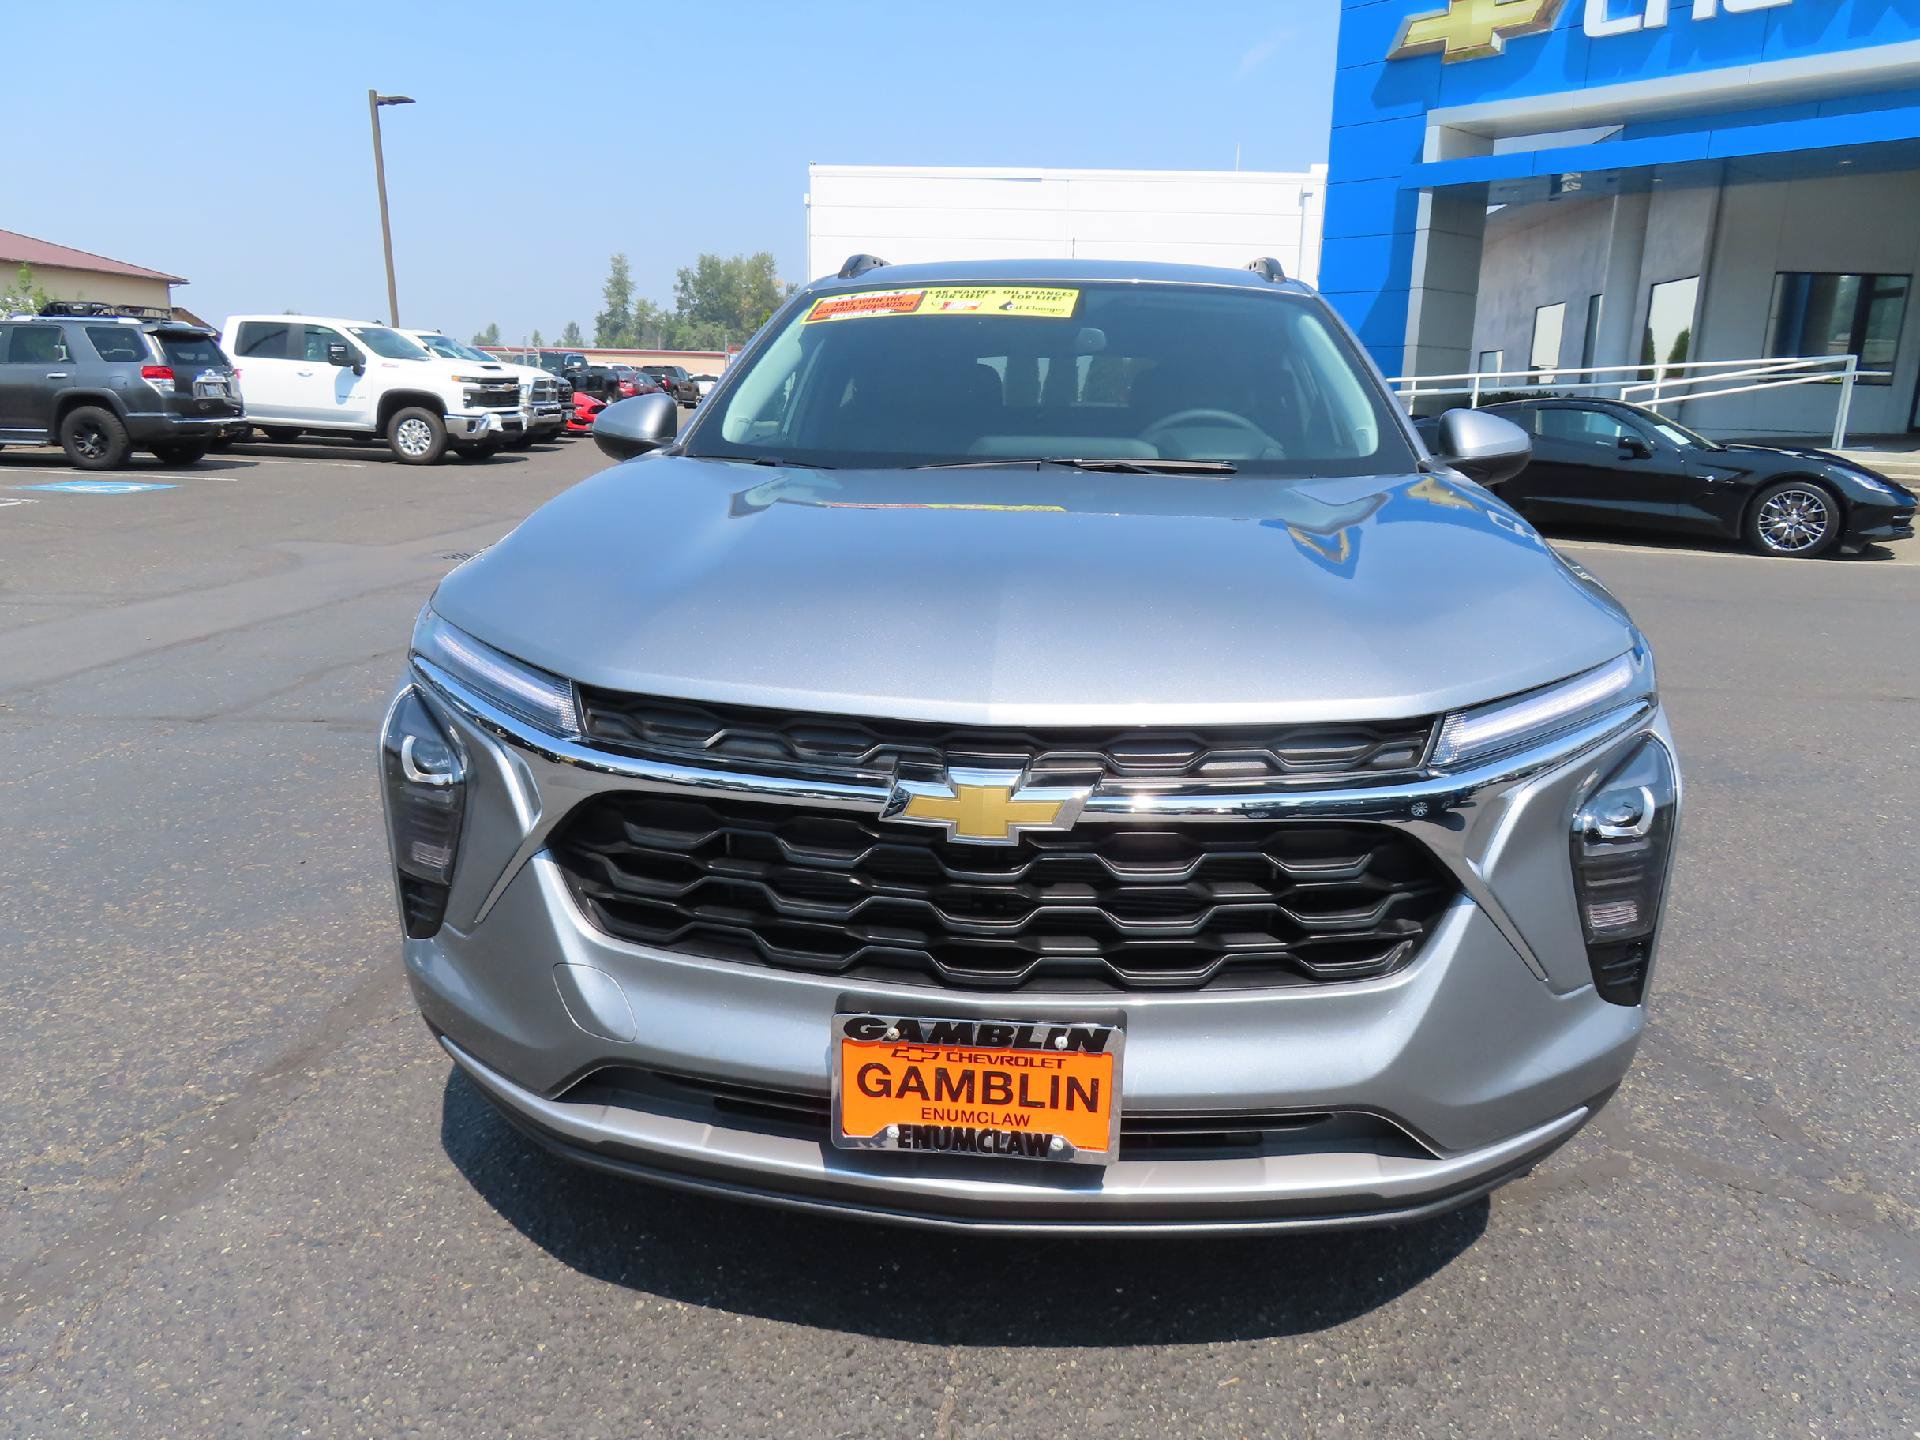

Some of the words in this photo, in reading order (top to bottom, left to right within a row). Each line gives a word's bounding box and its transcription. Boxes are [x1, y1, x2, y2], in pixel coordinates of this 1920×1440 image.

[843, 1016, 1112, 1053] GAMBLIN
[946, 1051, 1067, 1069] CHEVROLET
[856, 1062, 1100, 1113] GAMBLIN
[921, 1107, 1031, 1127] ENUMCLAW
[897, 1123, 1053, 1157] ENUMCLAW
